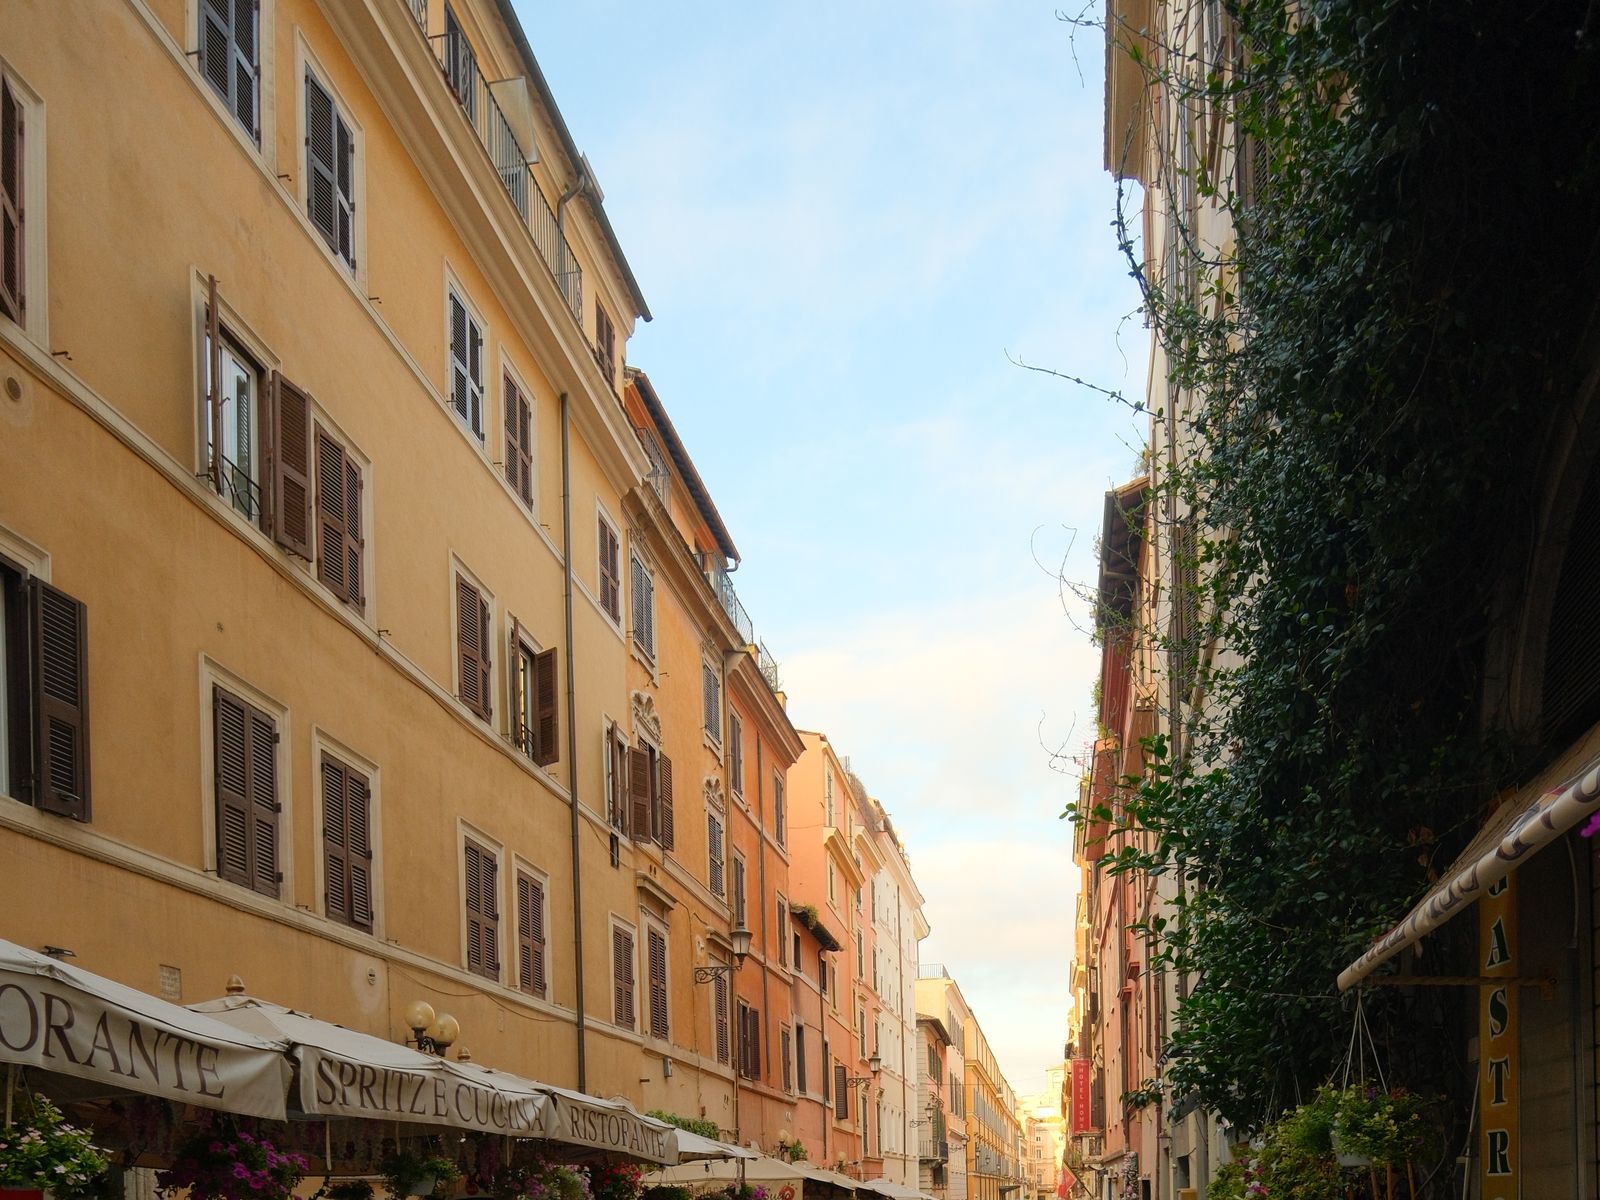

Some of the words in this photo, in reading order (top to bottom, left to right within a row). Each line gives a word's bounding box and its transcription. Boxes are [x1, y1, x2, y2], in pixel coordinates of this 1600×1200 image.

[316, 1055, 427, 1116] SPRITZ
[433, 1076, 450, 1118] E
[454, 1083, 545, 1132] CUCINA
[569, 1104, 666, 1159] RISTORANTE
